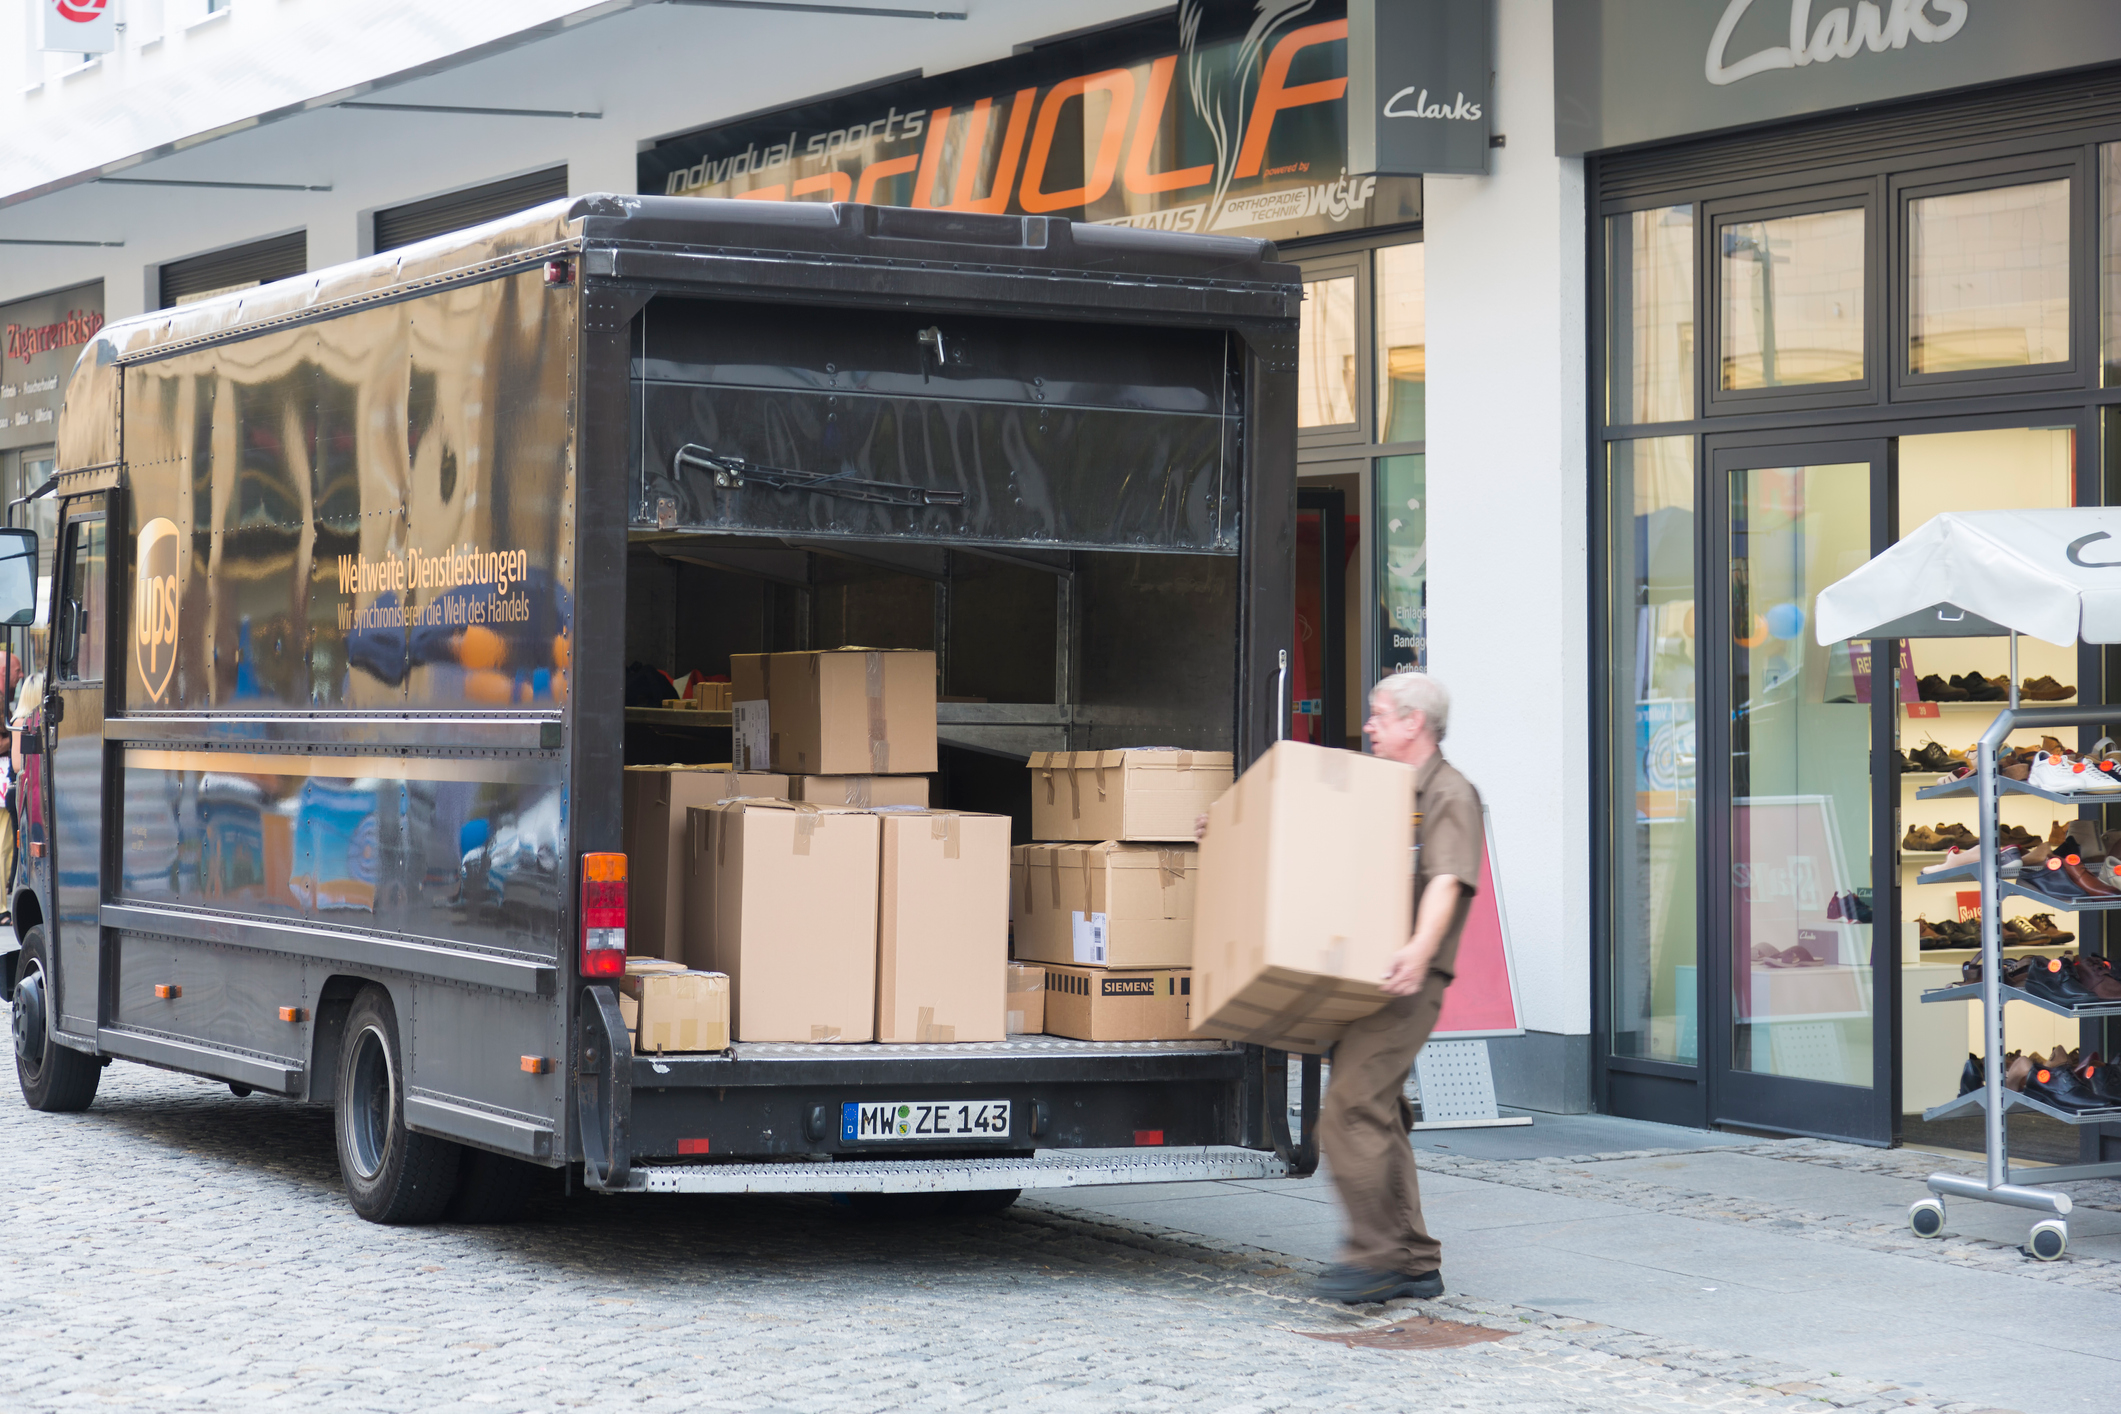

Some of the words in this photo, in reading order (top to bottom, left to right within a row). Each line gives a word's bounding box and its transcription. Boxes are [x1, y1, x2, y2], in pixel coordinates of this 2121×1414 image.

[1705, 0, 1968, 86] Clarks
[1383, 86, 1482, 120] Clarks
[665, 130, 797, 196] individual
[804, 106, 927, 167] sports
[1263, 162, 1298, 179] powered
[1299, 162, 1310, 173] by
[1227, 190, 1307, 213] ORTHOPÄDIE-
[1307, 167, 1377, 222] WOLF
[1251, 204, 1301, 222] TECHNIK
[6, 309, 104, 364] Zigarrenkiste
[337, 550, 404, 595] Weltweite
[408, 543, 527, 596] Dienstleistungen
[139, 574, 176, 674] ups
[337, 602, 352, 630] Wir
[353, 598, 425, 637] synchronisieren
[426, 597, 442, 626] die
[444, 595, 466, 625] Welt
[468, 594, 486, 624] des
[488, 591, 530, 622] Handels
[1393, 634, 1427, 651] Bandag
[1959, 905, 1982, 923] Sale
[1104, 981, 1154, 993] SIEMENS
[847, 1125, 854, 1134] D
[860, 1106, 897, 1135] MW
[915, 1105, 950, 1134] ZE
[956, 1104, 1008, 1134] 143
